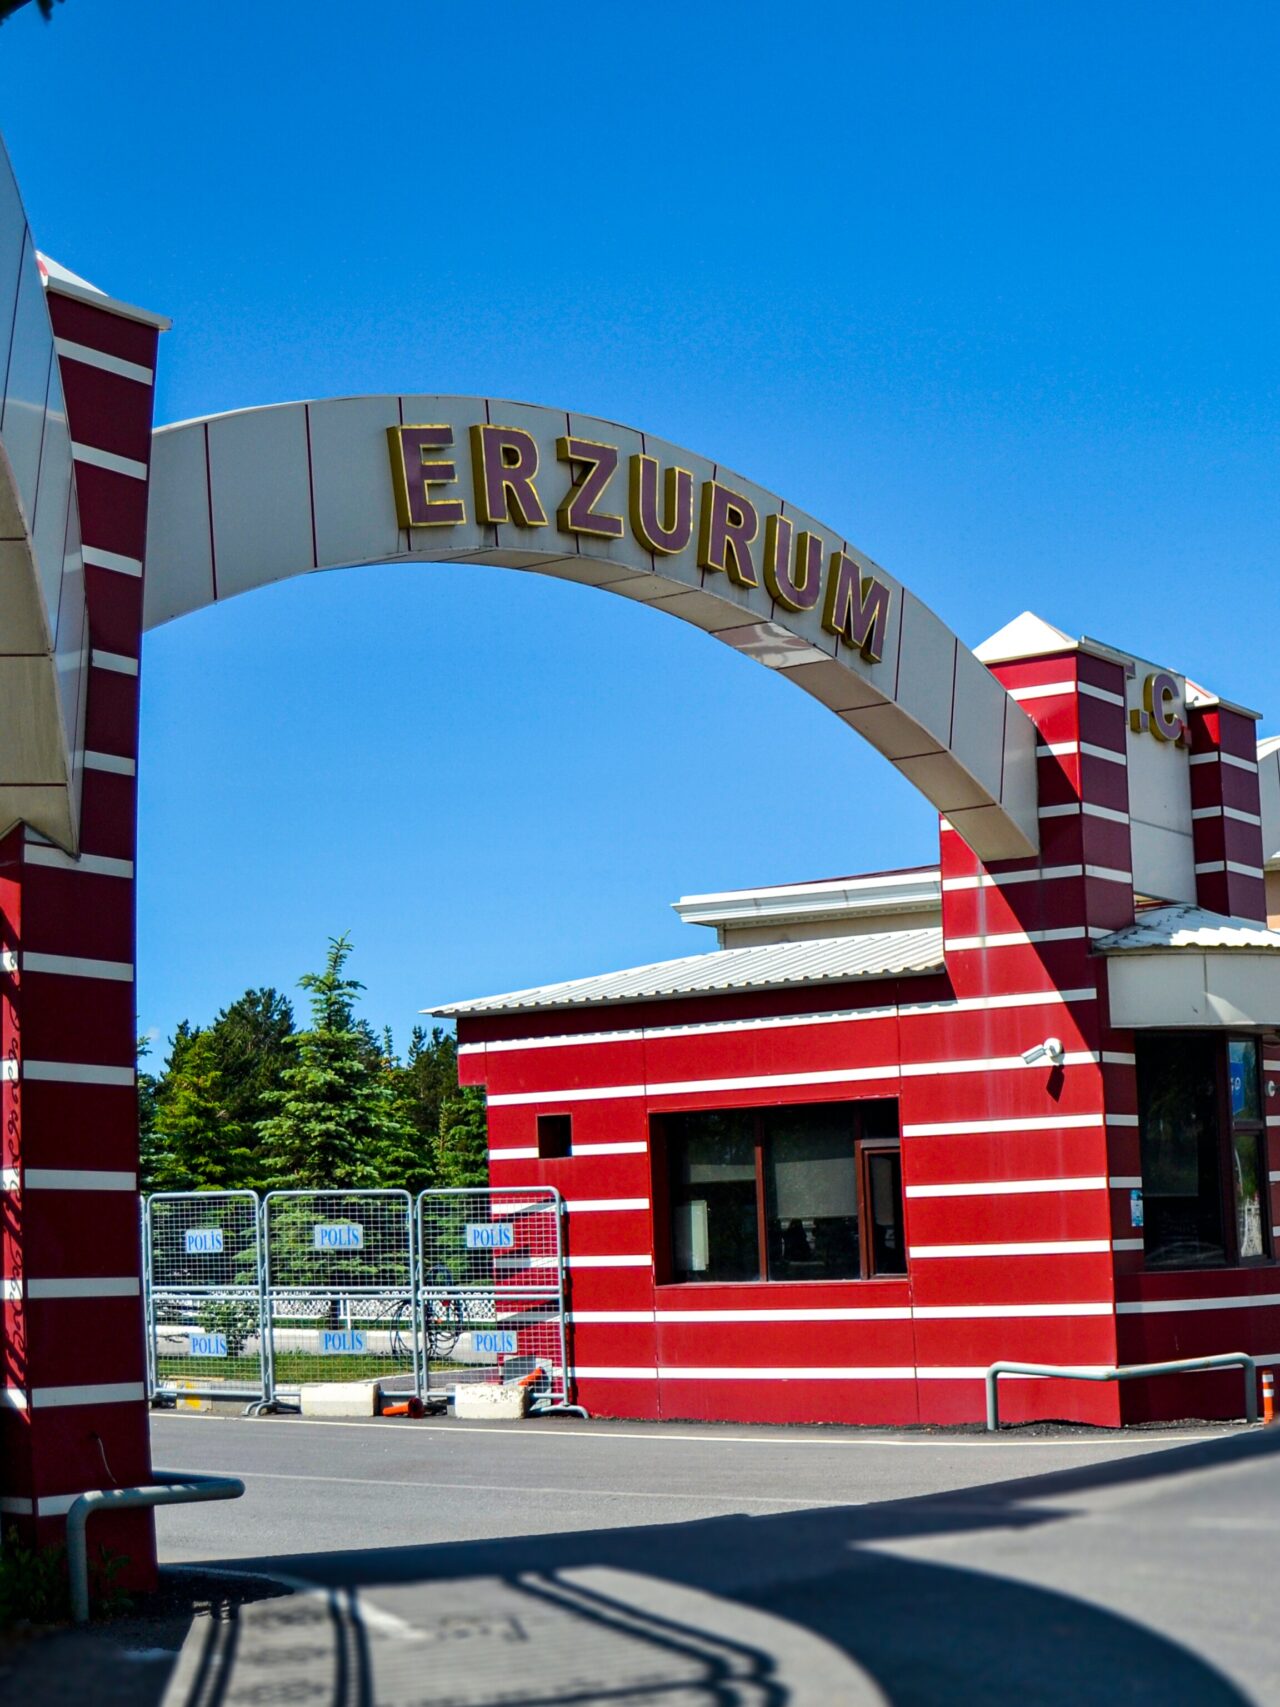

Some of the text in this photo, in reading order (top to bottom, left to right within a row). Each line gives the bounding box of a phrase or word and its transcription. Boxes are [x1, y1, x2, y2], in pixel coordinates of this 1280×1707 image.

[387, 424, 892, 664] ERZURUM
[1125, 662, 1192, 749] .C.
[188, 1231, 222, 1251] POLİS
[320, 1226, 359, 1246] POLİS
[473, 1225, 511, 1246] POLİS
[191, 1336, 228, 1354] POLİS
[324, 1330, 363, 1350] POLİS
[475, 1331, 512, 1351] POLİS
